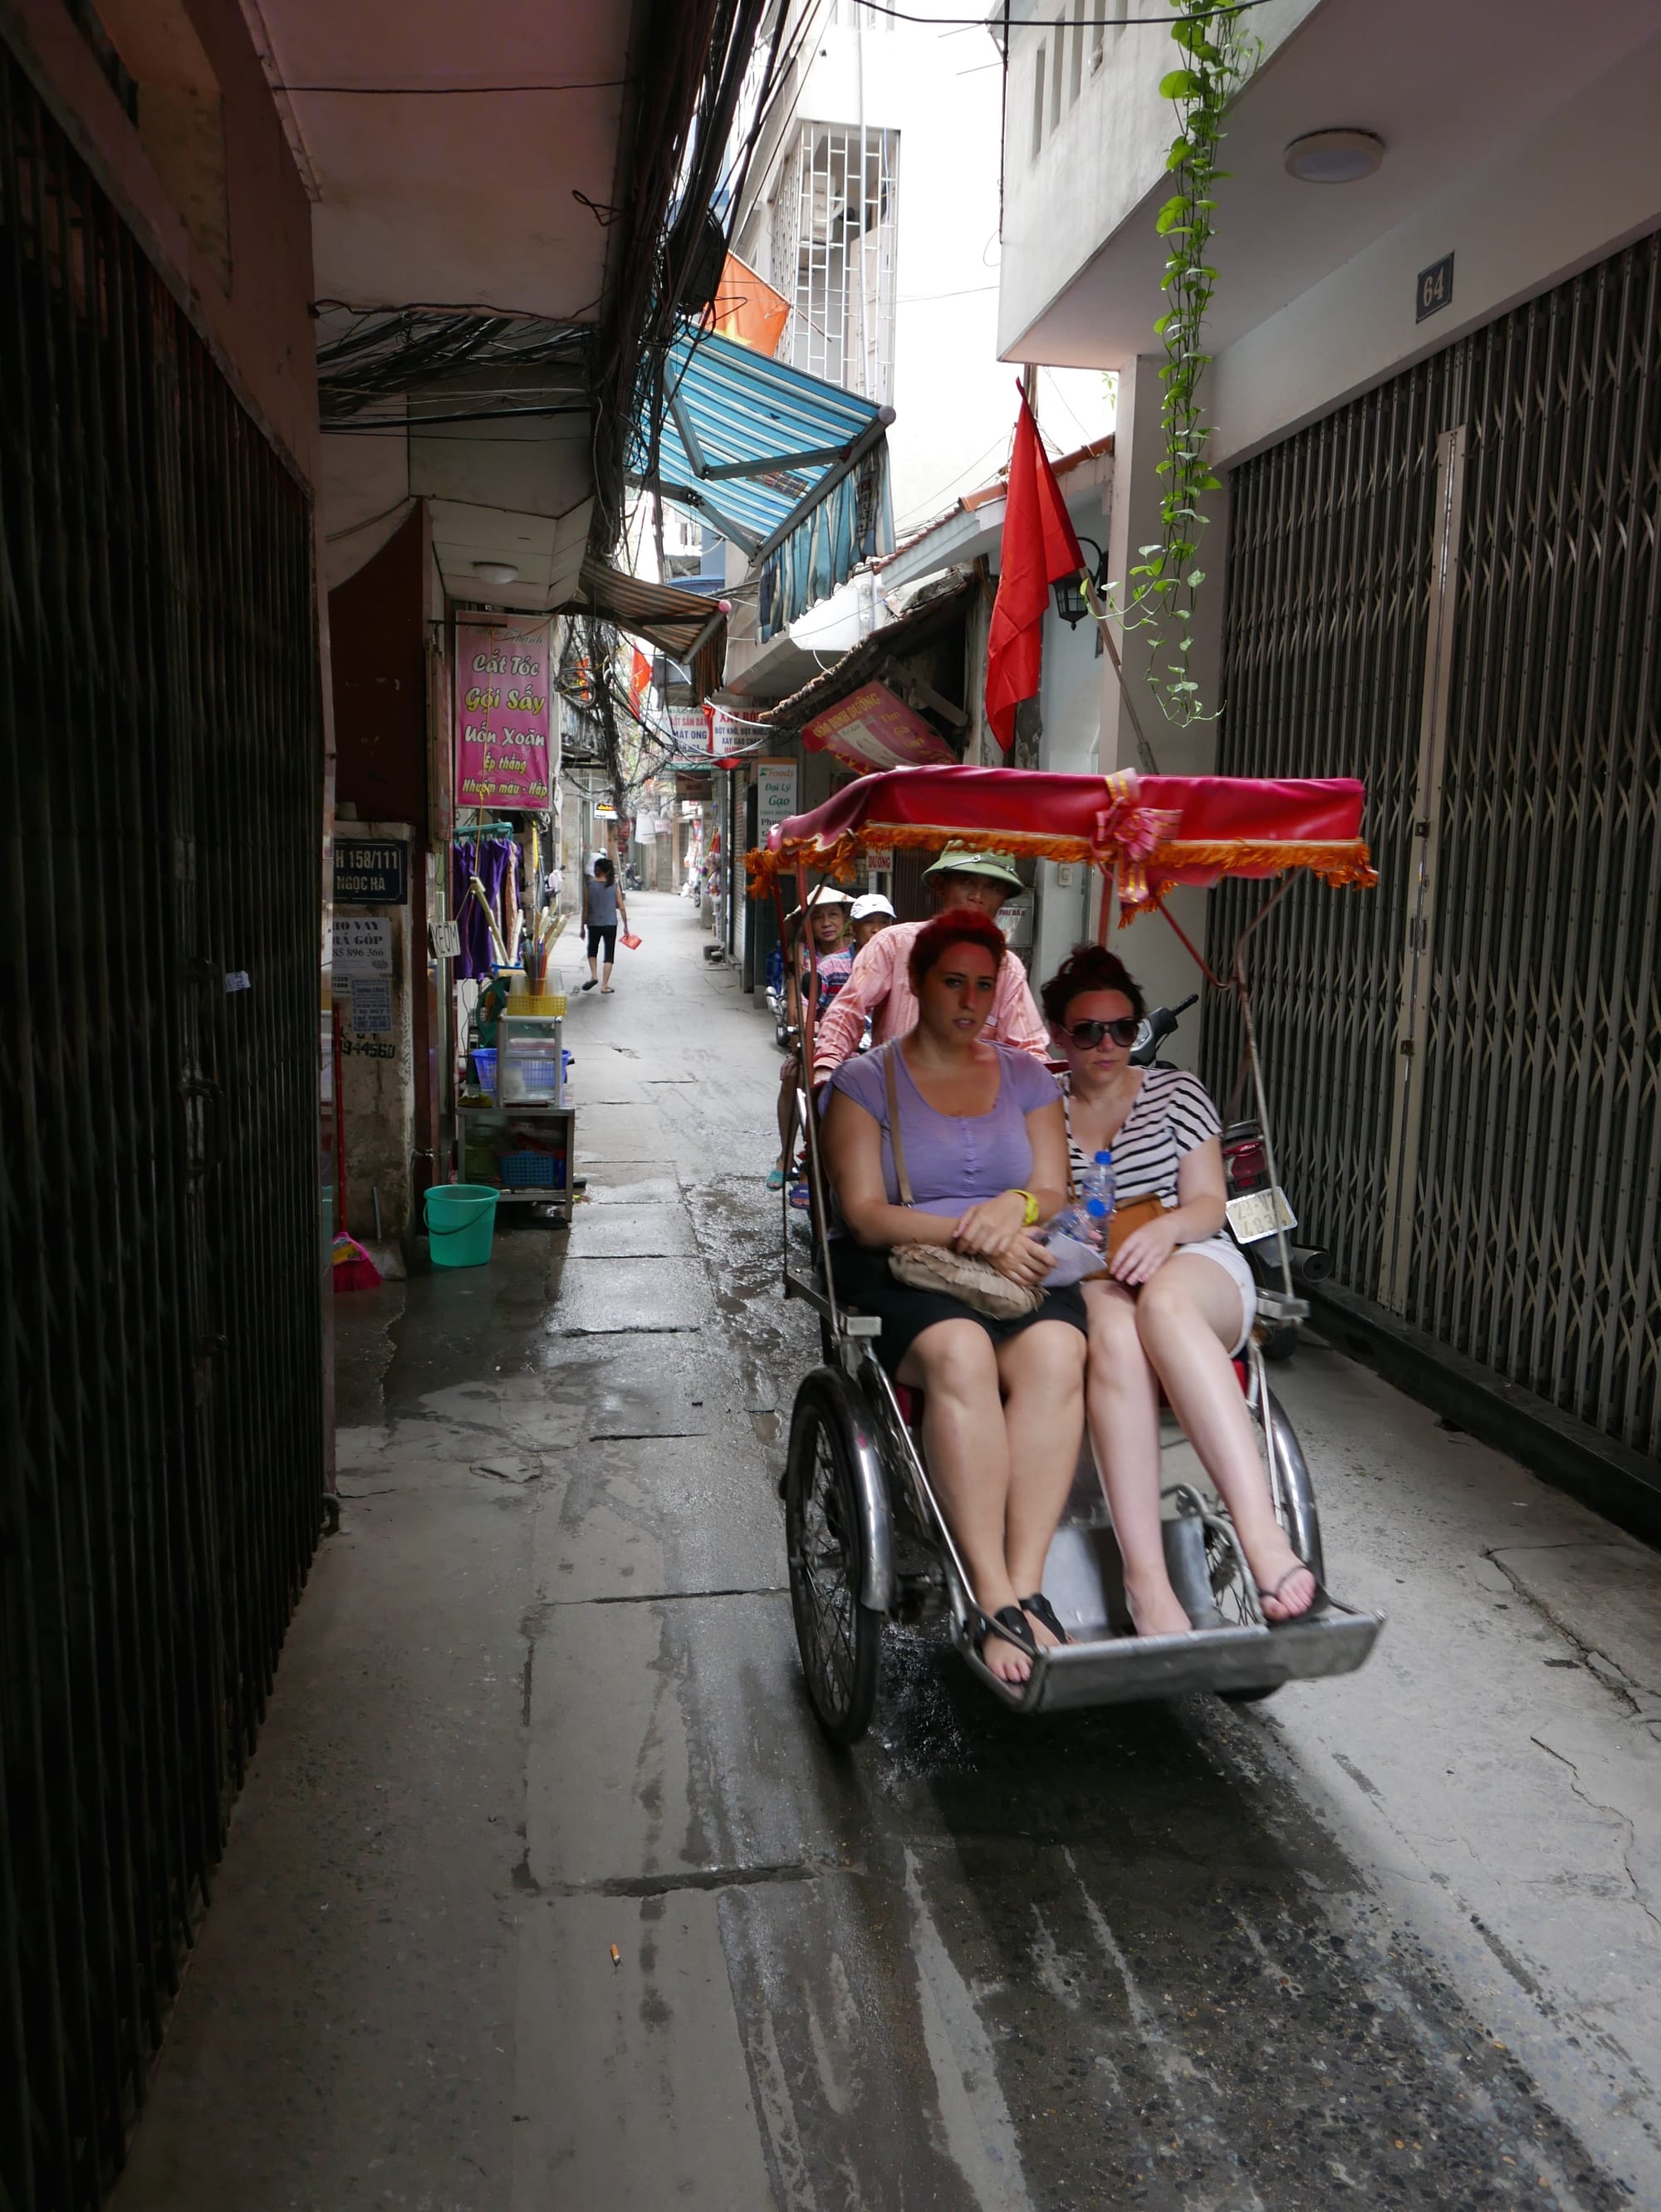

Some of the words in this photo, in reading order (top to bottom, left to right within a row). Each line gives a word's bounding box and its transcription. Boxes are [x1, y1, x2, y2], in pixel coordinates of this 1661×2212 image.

[1423, 267, 1444, 307] 64
[472, 649, 507, 674] Cắt
[510, 655, 540, 677] Tóc
[464, 686, 501, 715] Gội
[506, 684, 546, 715] Sấy
[464, 721, 497, 743] Uốn
[501, 728, 546, 747] Xoăn
[691, 730, 708, 739] ONG
[498, 753, 527, 775] thẳng
[498, 779, 521, 796] màu
[527, 778, 548, 800] Hấp
[765, 782, 778, 792] Đại
[769, 794, 790, 807] Gạo
[348, 850, 398, 870] 158/111
[336, 876, 367, 894] NGỌC
[332, 922, 350, 931] HO
[354, 922, 380, 931] VAY
[332, 932, 350, 945] RẢ
[354, 933, 383, 945] GÓP
[332, 948, 344, 957] 85
[346, 949, 365, 957] 896
[366, 949, 384, 957] 366
